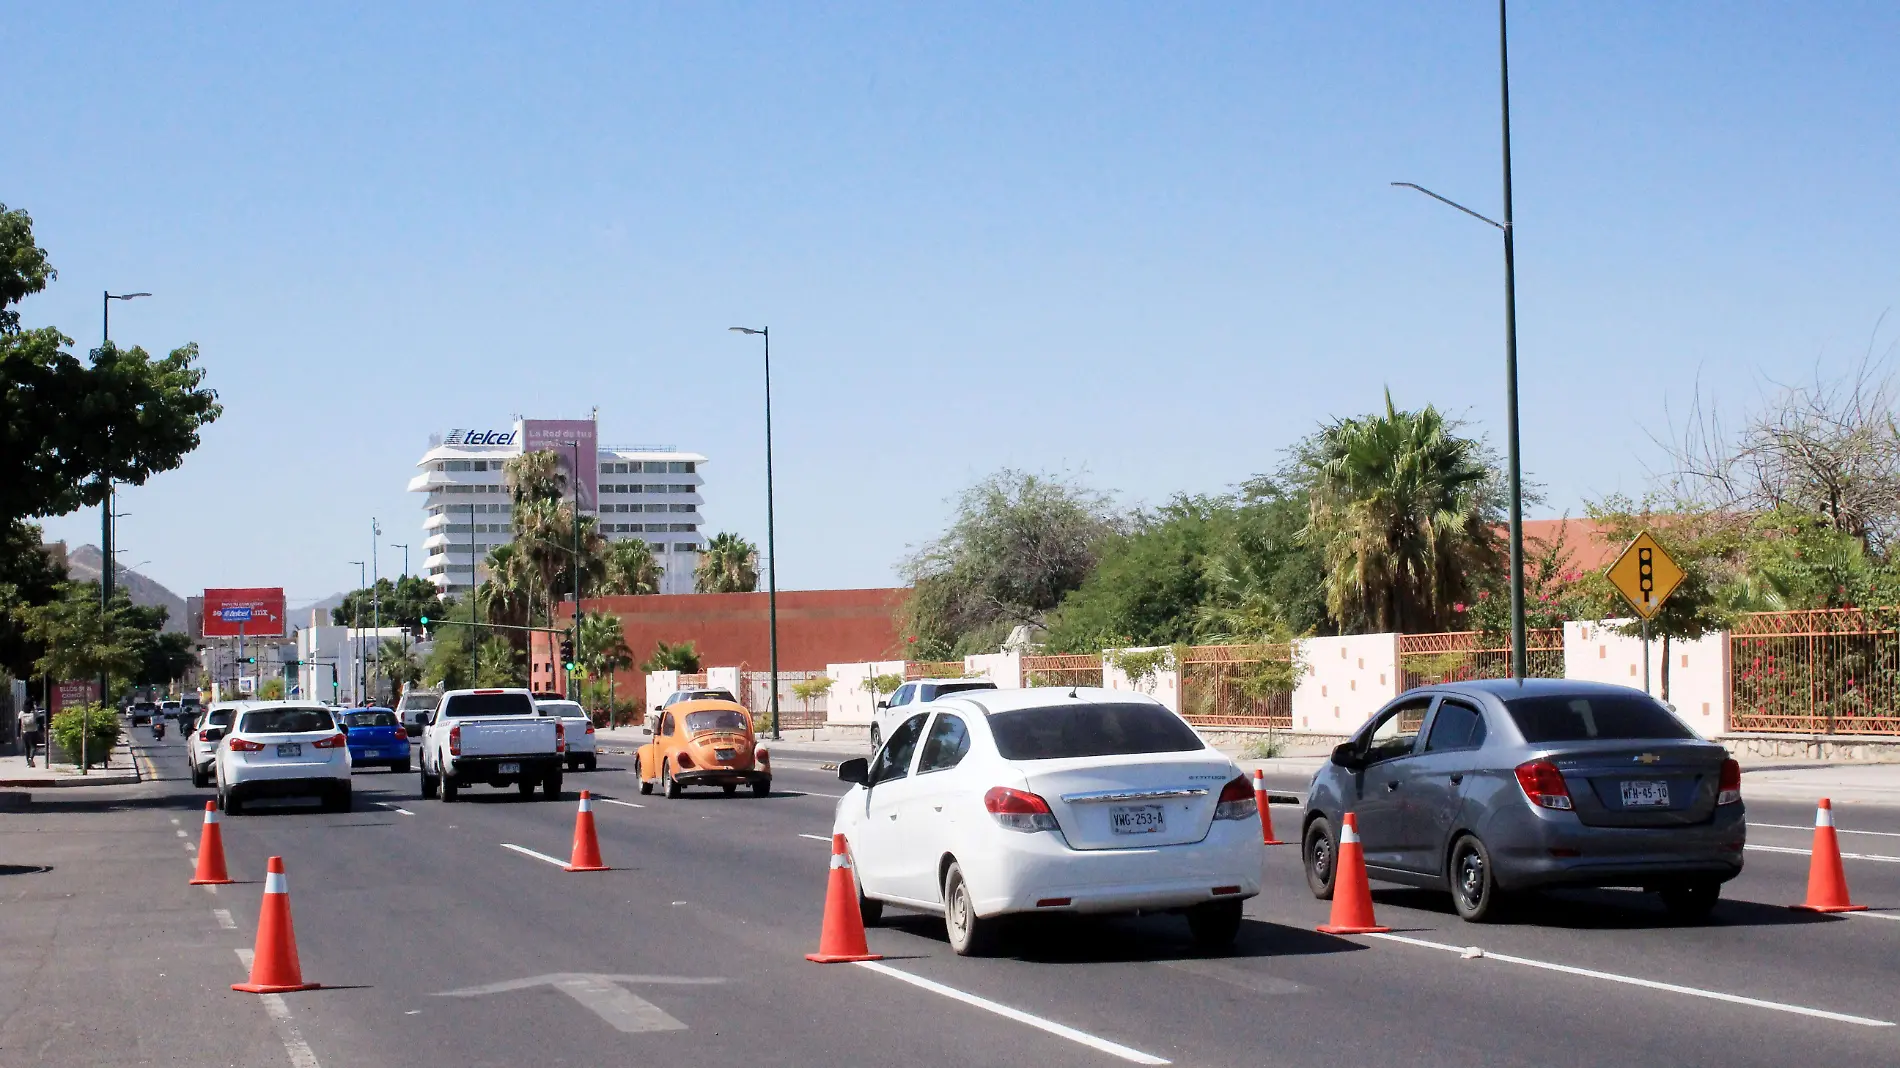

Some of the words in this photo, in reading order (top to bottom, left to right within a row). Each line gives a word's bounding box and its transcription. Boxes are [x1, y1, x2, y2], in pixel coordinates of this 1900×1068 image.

[463, 429, 518, 445] telcel
[529, 430, 541, 438] La
[543, 430, 561, 438] Red
[562, 430, 574, 438] de
[1113, 811, 1164, 826] VWG-253-A
